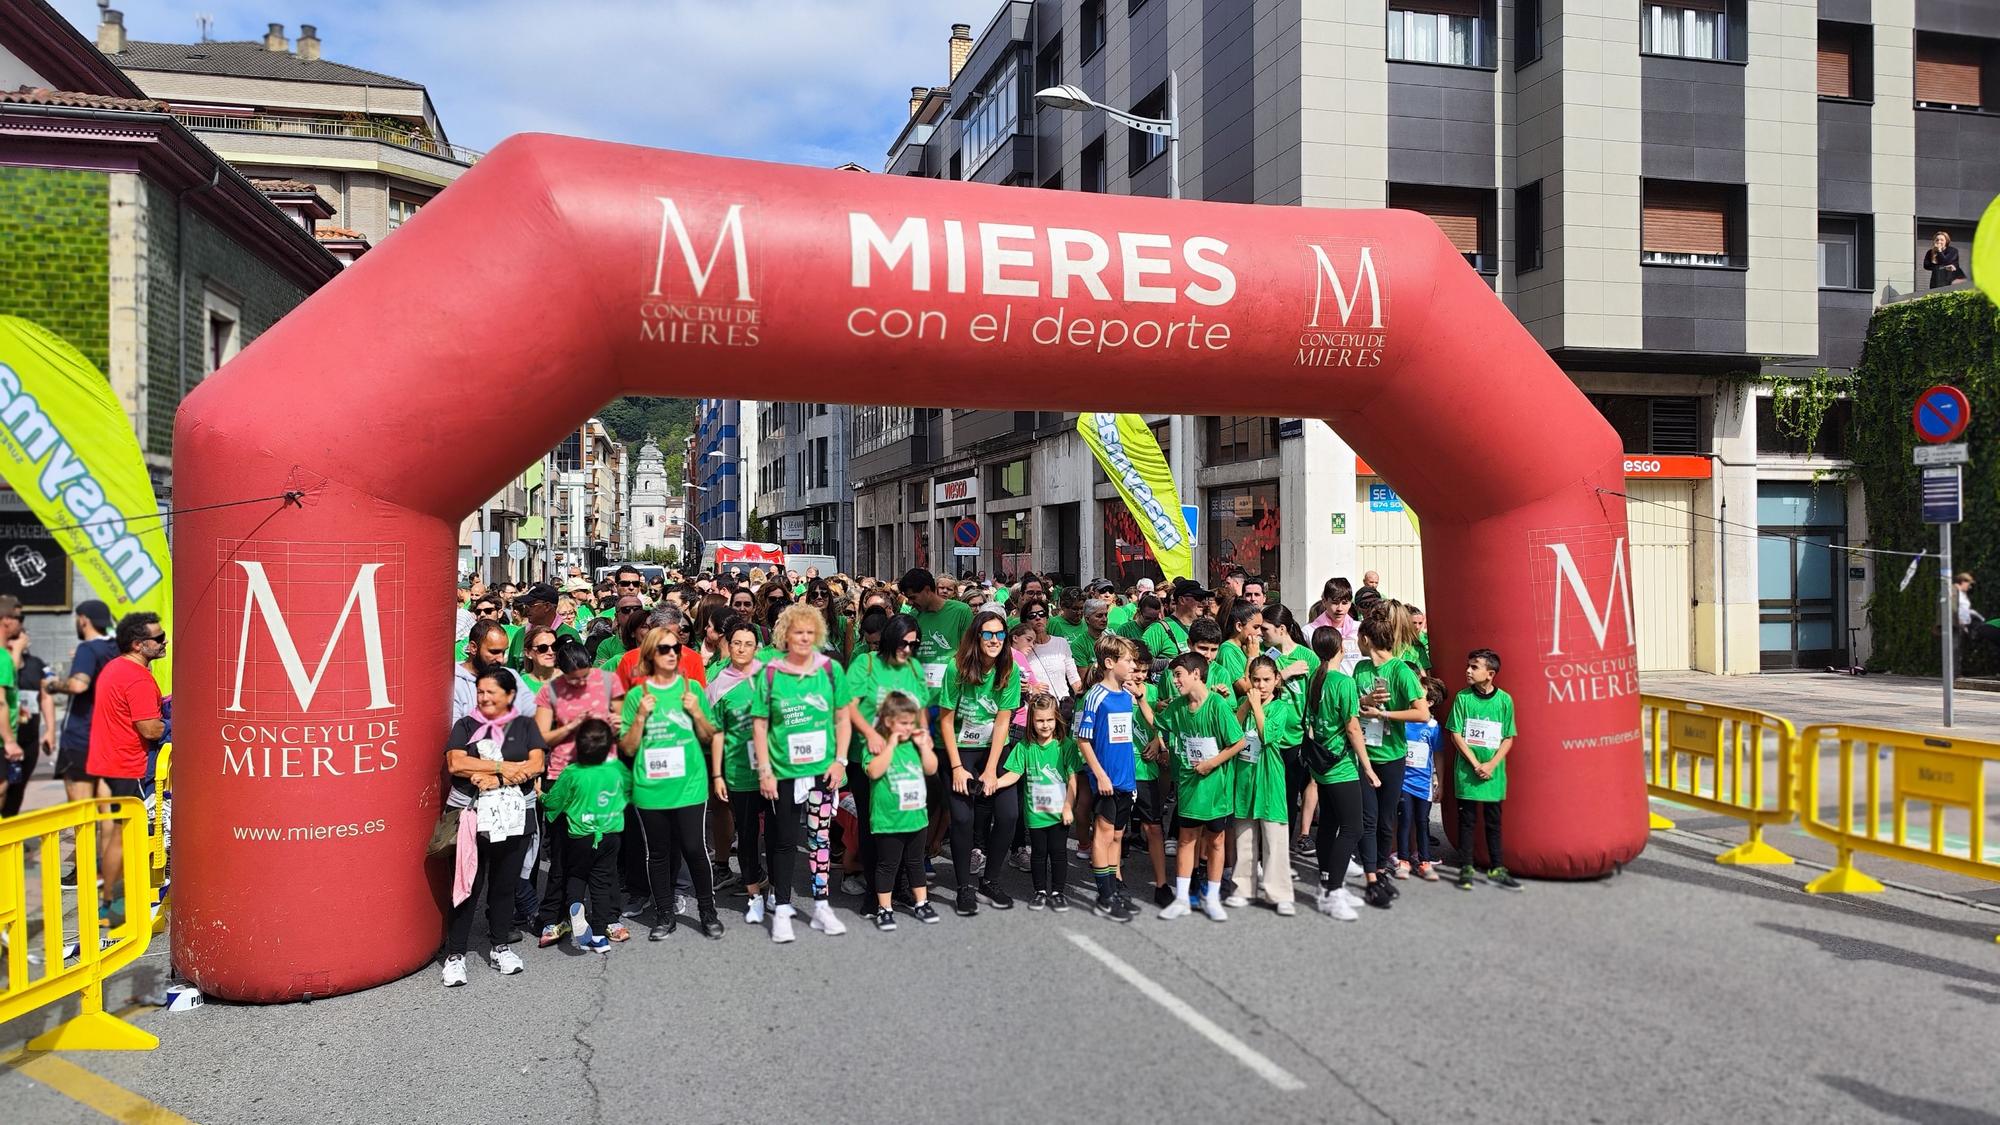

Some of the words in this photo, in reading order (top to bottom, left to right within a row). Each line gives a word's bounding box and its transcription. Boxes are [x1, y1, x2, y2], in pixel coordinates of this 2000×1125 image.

[648, 196, 755, 301] M
[849, 212, 1238, 306] MIERES
[1306, 244, 1385, 328] M
[640, 303, 732, 322] CONCEYU
[736, 308, 761, 325] DE
[640, 320, 760, 347] MIERES
[847, 307, 947, 341] con
[969, 304, 1012, 343] el
[1032, 306, 1231, 353] deporte
[1300, 333, 1365, 347] CONCEYU
[1367, 334, 1387, 348] DE
[1294, 348, 1382, 367] MIERES
[1373, 489, 1387, 500] SE
[1545, 537, 1636, 656] M
[226, 560, 396, 713] M
[1544, 656, 1626, 679] CONCEYU
[220, 724, 354, 744] CONCEYU
[368, 719, 400, 740] DE
[963, 730, 980, 740] 560
[1113, 724, 1127, 735] 337
[1470, 728, 1485, 739] 321
[220, 740, 400, 779] MIERES
[793, 744, 812, 755] 708
[649, 760, 667, 769] 694
[903, 791, 919, 802] 562
[233, 818, 386, 841] www.mieres.es
